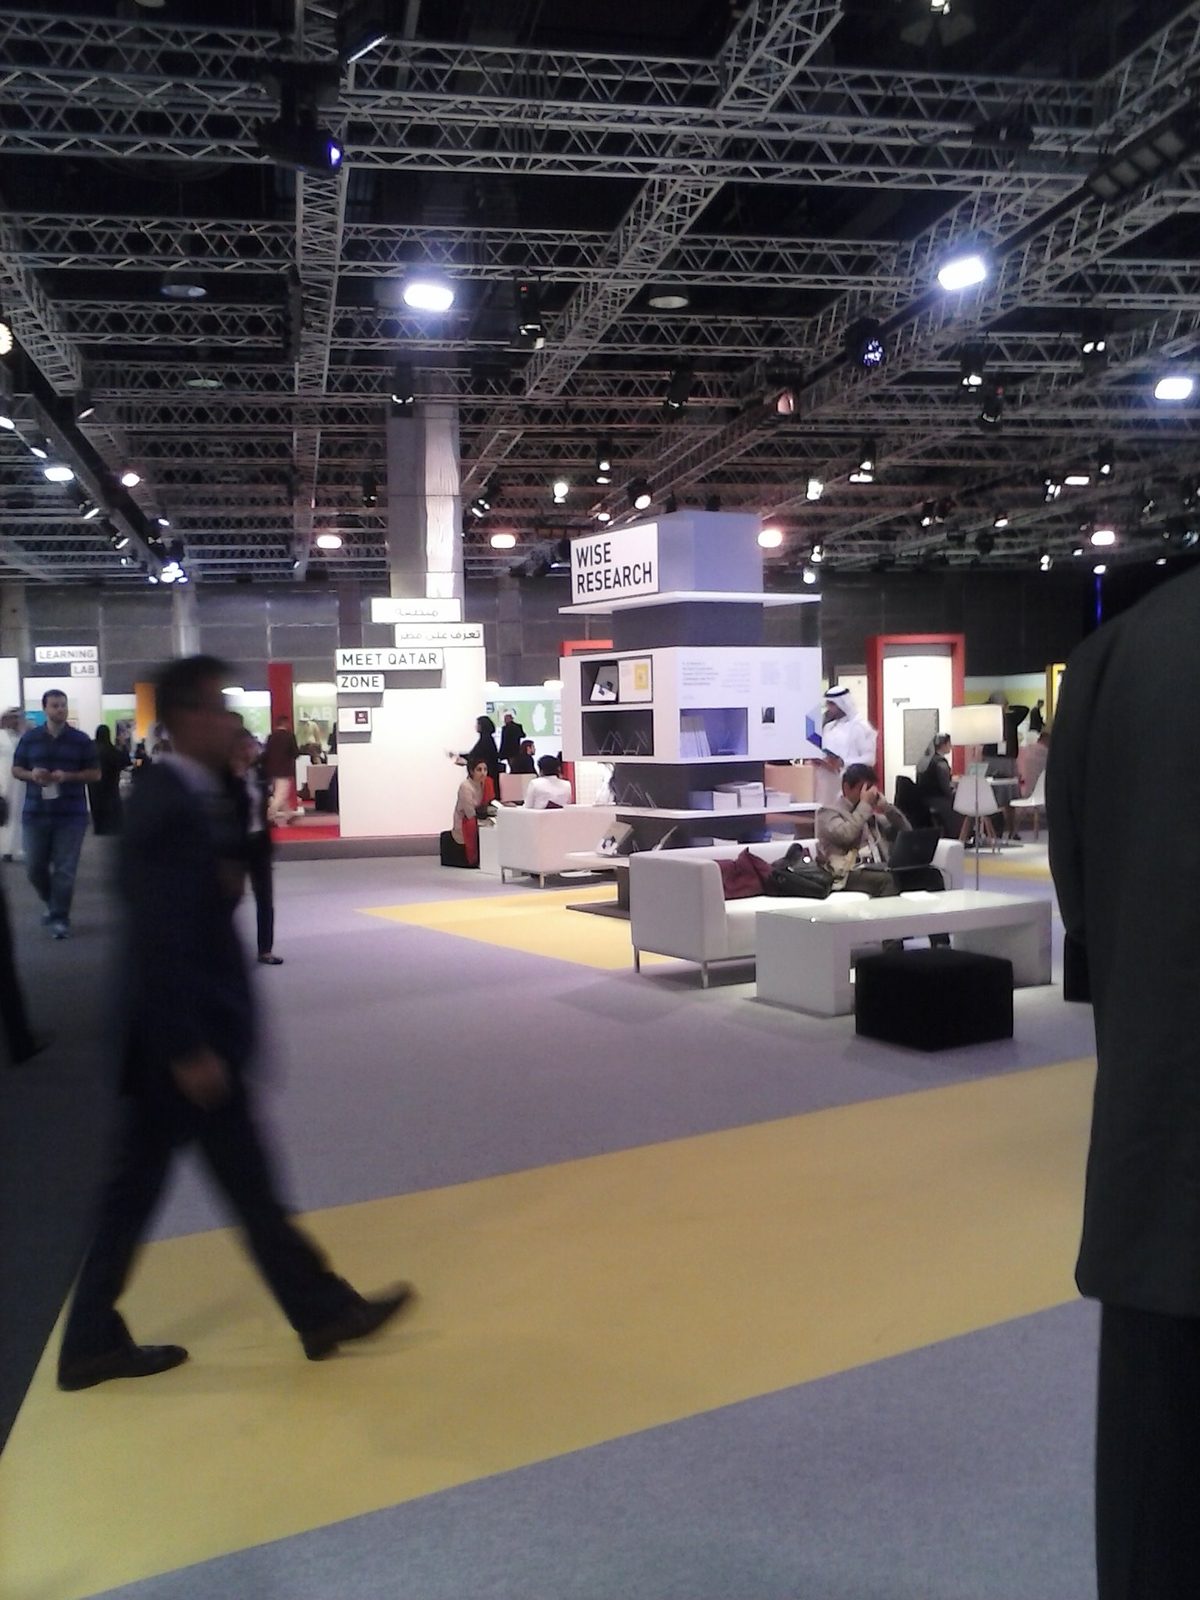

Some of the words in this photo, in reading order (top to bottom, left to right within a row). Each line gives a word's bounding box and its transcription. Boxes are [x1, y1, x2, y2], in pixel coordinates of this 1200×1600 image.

[576, 542, 611, 568] WISE
[577, 561, 652, 594] RESEARCH
[39, 649, 94, 660] LEARNING
[342, 653, 382, 666] MEET
[388, 652, 437, 665] QATAR
[73, 665, 95, 674] LAB
[341, 676, 379, 688] ZONE
